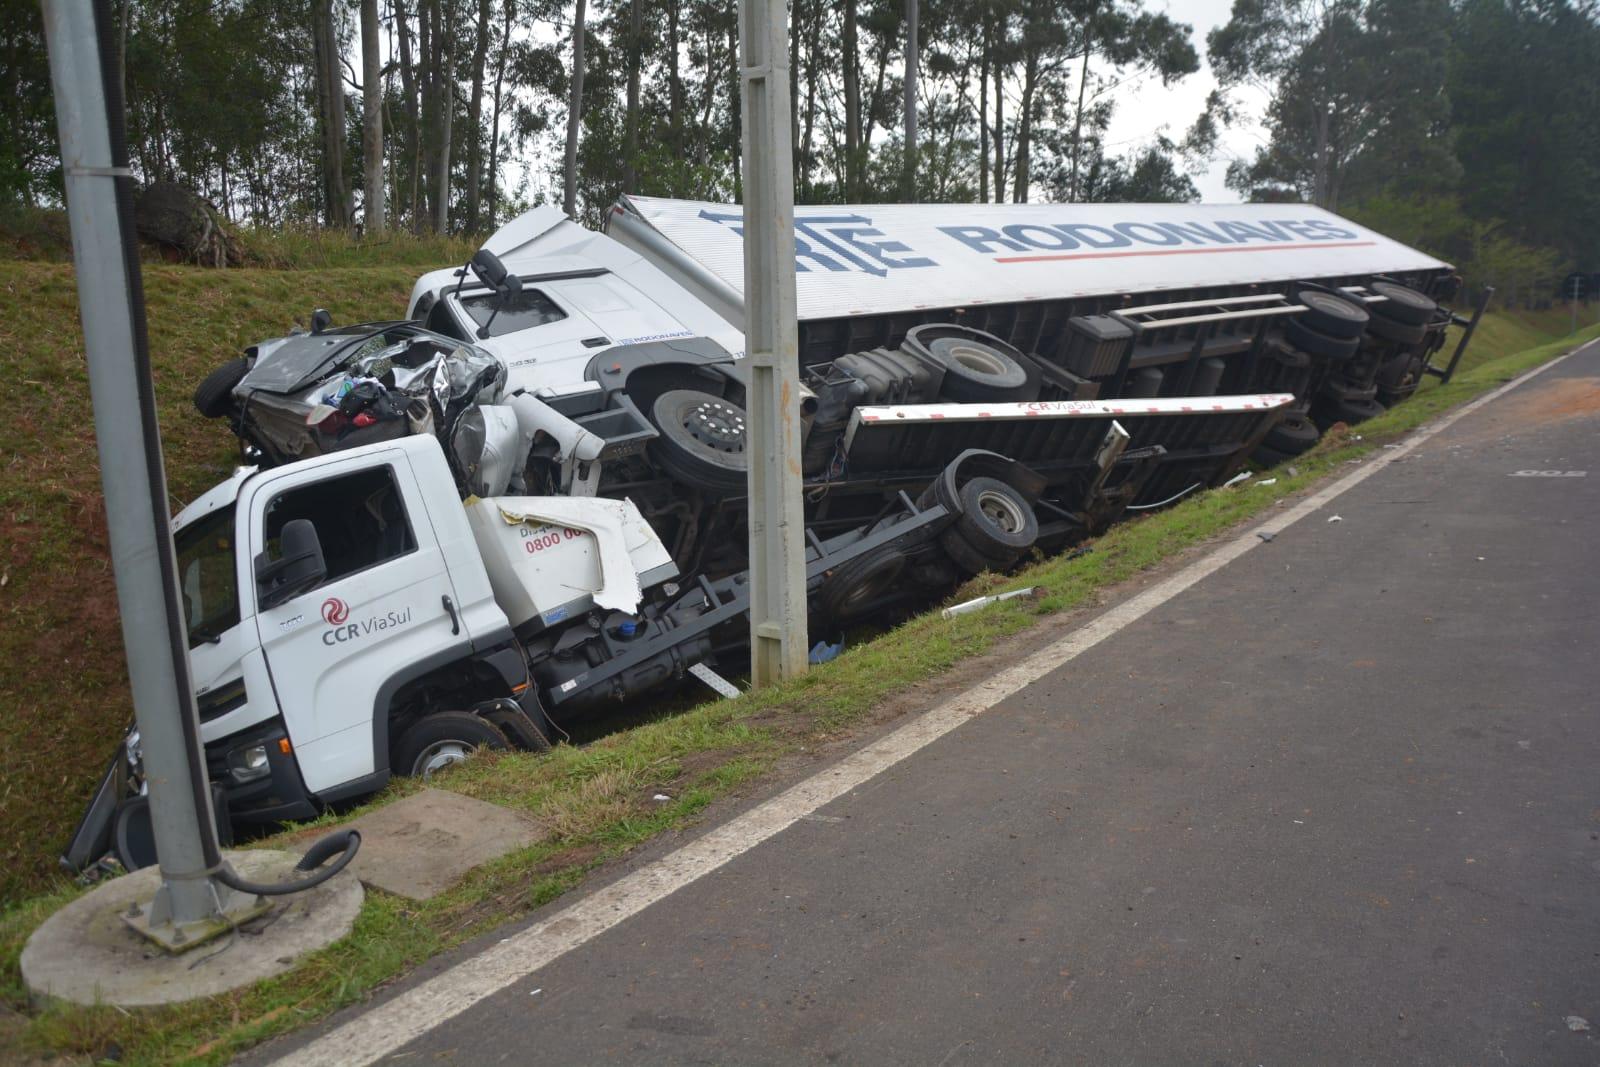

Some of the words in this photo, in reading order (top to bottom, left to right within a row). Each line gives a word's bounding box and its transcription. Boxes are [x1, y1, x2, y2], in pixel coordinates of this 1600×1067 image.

[935, 219, 1359, 254] RODONAVES
[1052, 400, 1097, 410] ViaSul
[525, 532, 561, 554] 0800
[563, 527, 590, 540] 00
[322, 623, 360, 646] CCR
[361, 607, 412, 634] ViaSul
